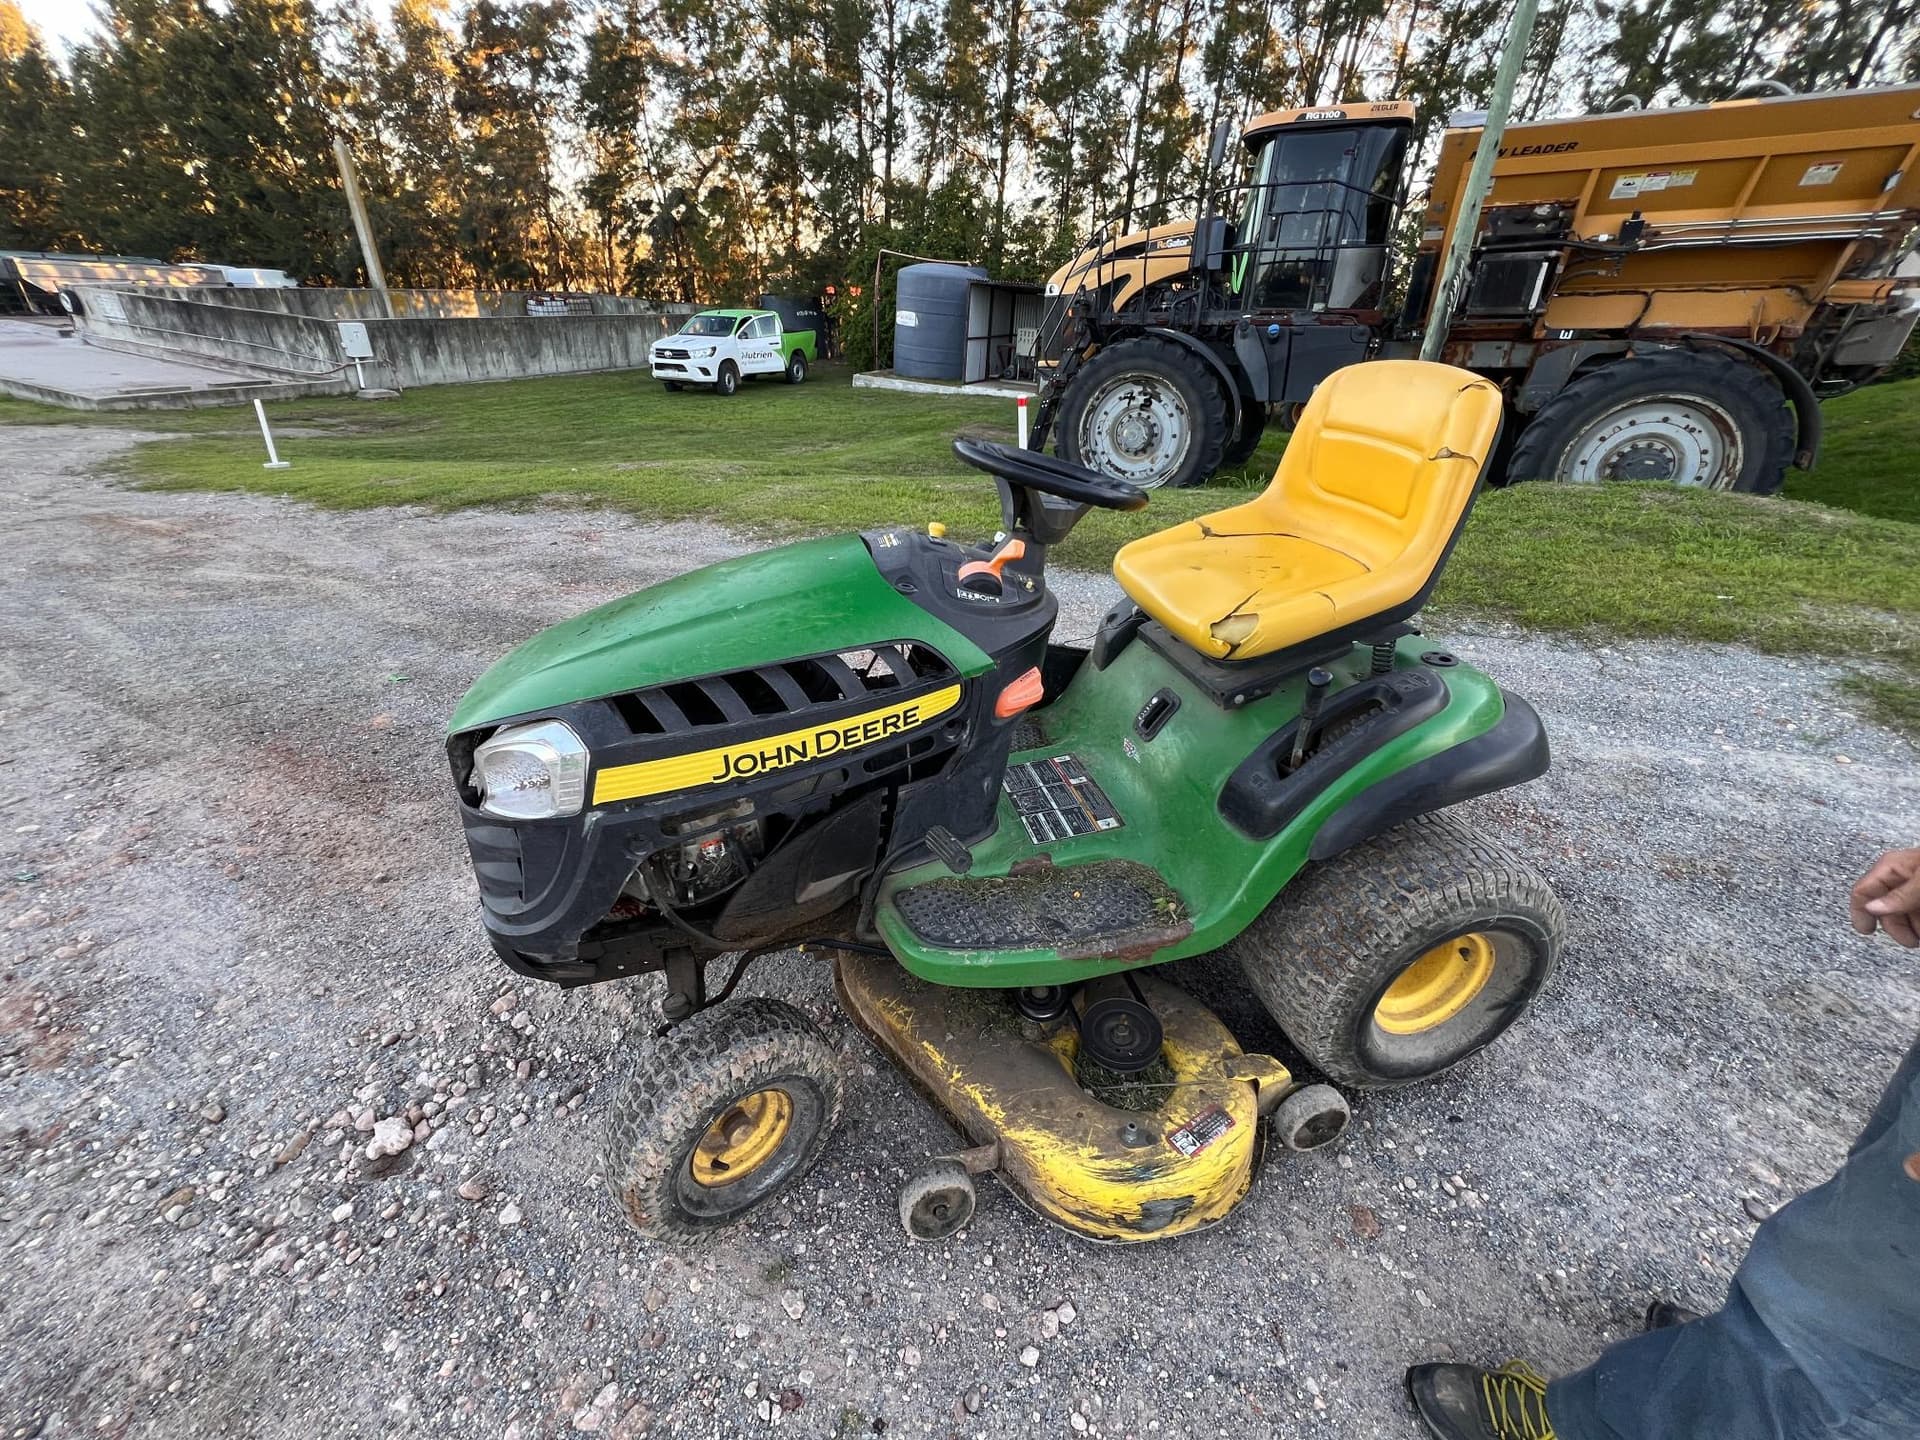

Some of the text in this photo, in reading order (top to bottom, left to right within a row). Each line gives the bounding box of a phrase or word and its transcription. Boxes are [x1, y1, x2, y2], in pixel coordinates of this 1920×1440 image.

[1371, 103, 1399, 112] ZIEGLER
[1510, 142, 1579, 157] LEADER
[713, 706, 920, 781] JOHN DEERE
